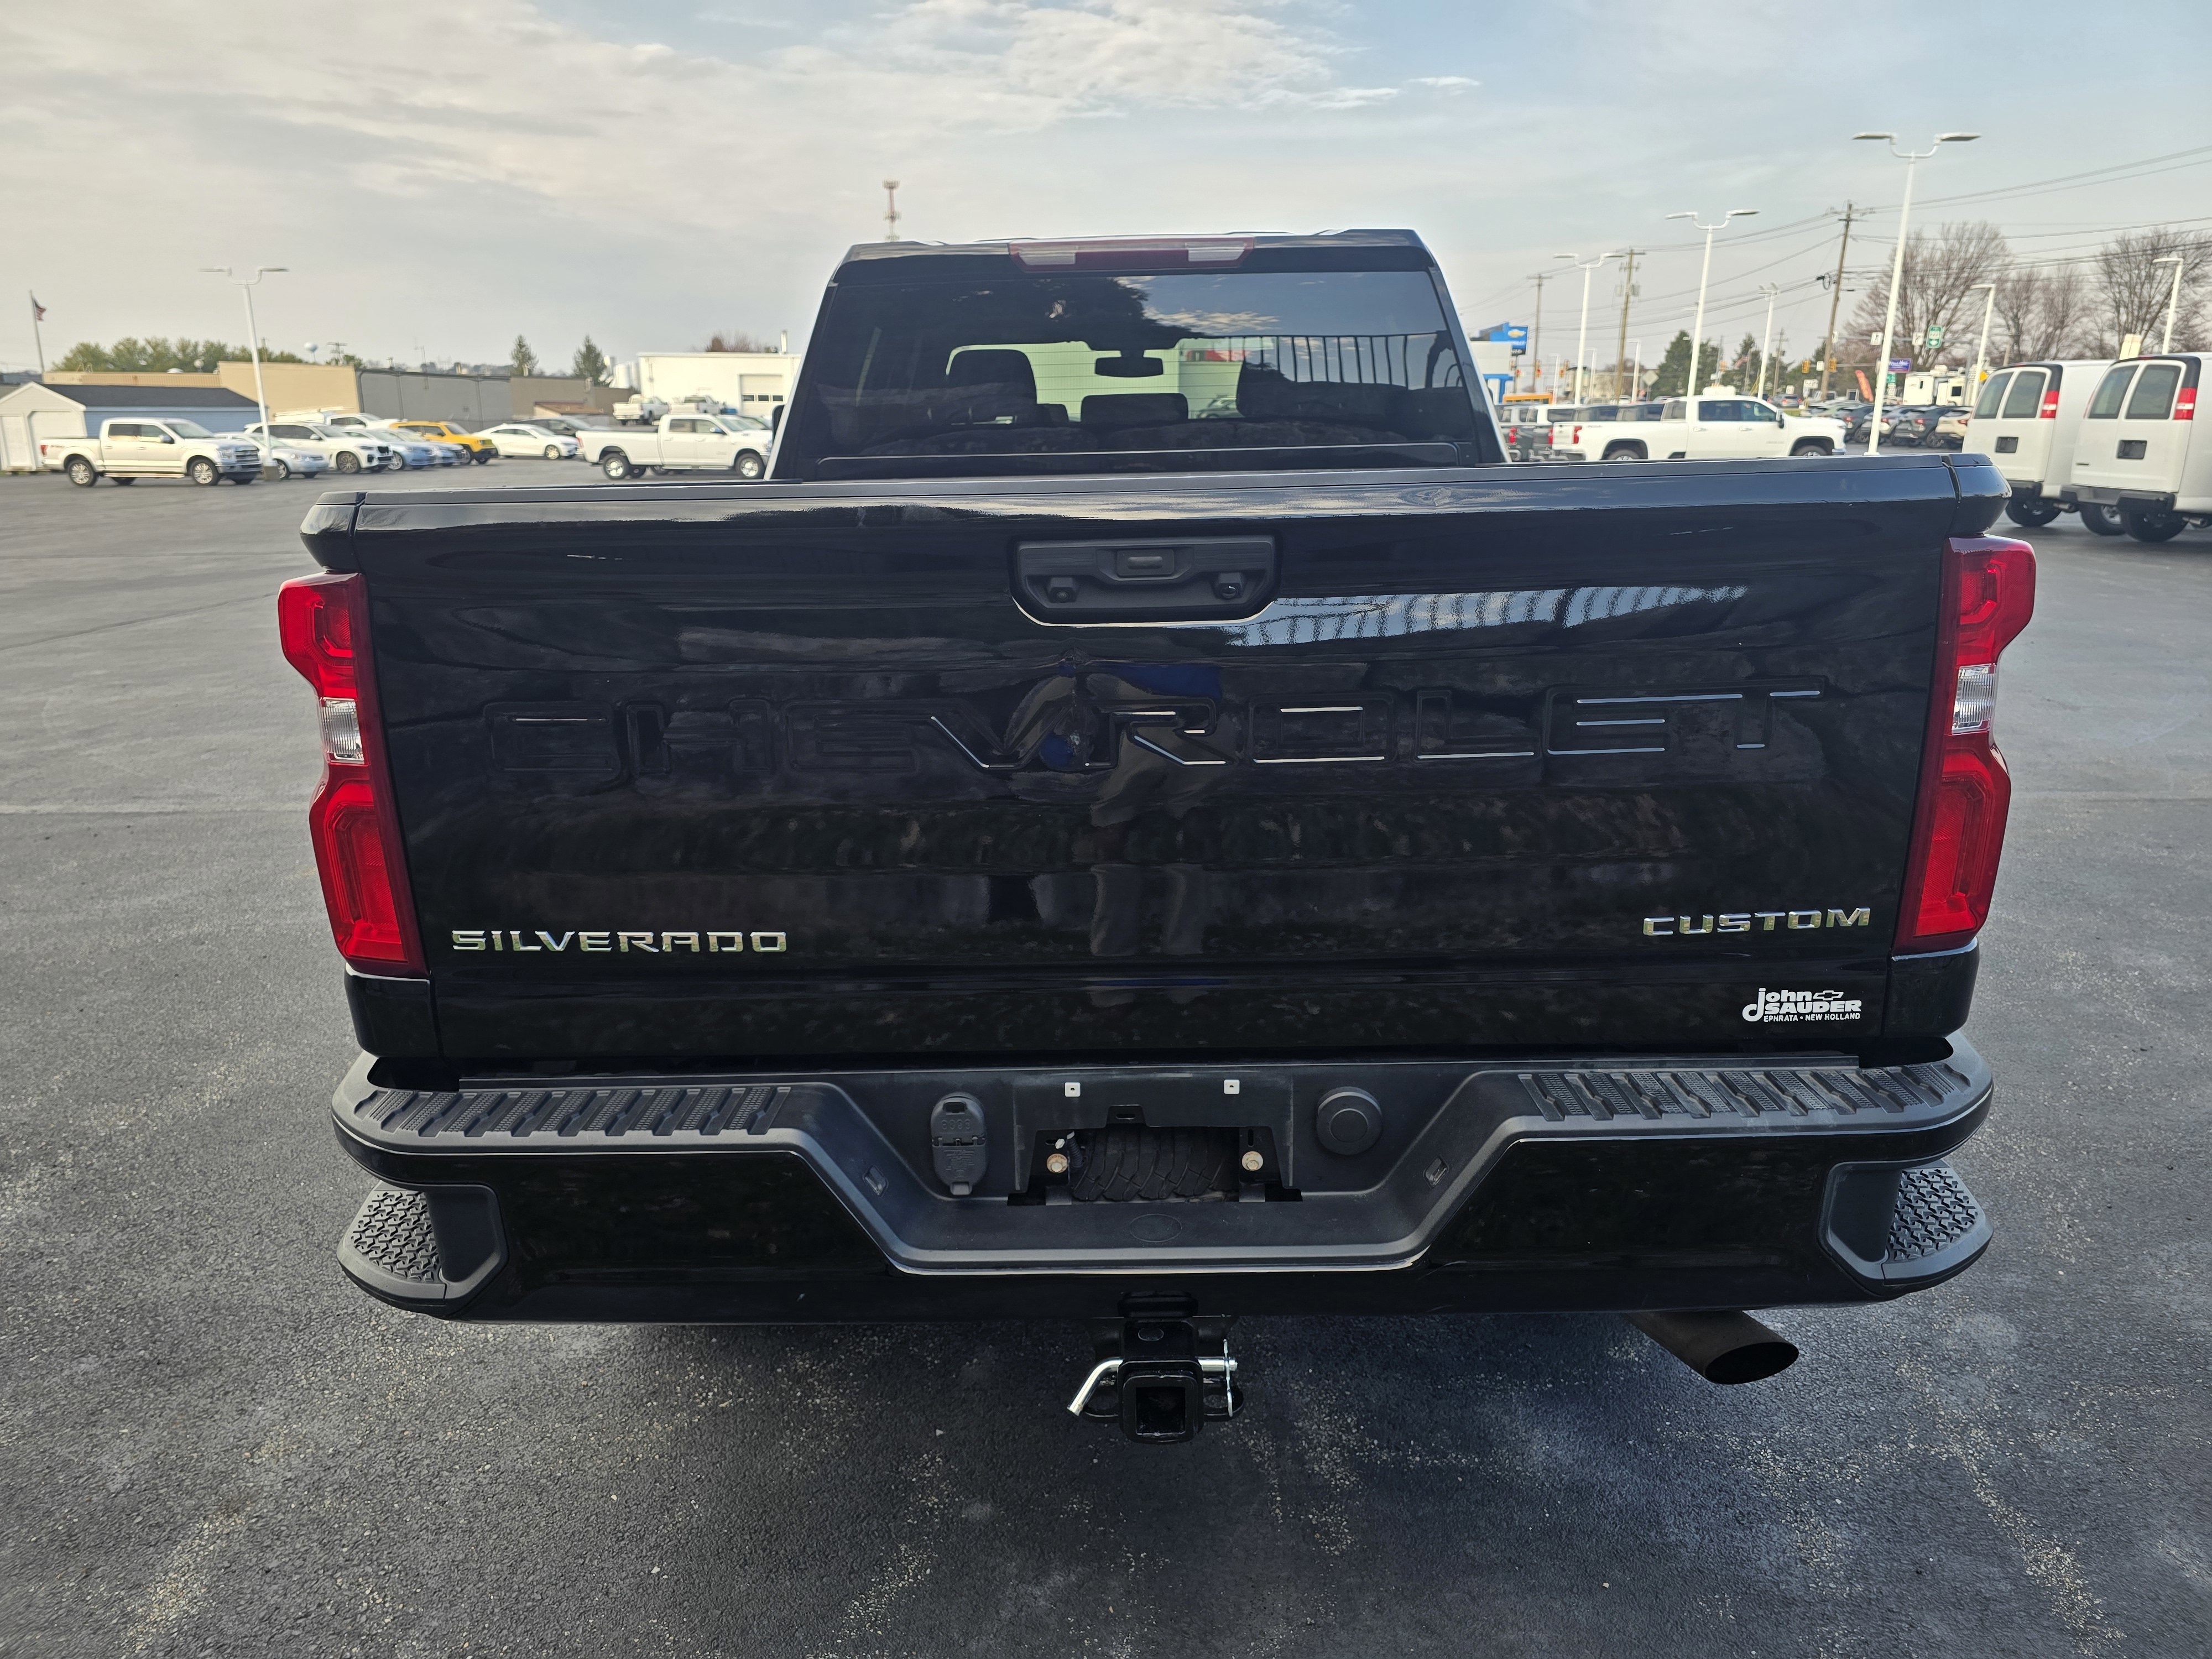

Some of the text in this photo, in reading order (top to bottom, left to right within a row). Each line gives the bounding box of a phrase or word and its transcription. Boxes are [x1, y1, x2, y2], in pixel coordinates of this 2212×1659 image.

[486, 678, 1827, 774] CHEVROLET
[1642, 906, 1871, 936] CUSTOM
[451, 930, 788, 952] SILVERADO
[1742, 988, 1812, 1022] john
[1764, 1013, 1861, 1022] EPHRATA NEW HOLLAND
[1765, 1000, 1861, 1014] SAUDER
